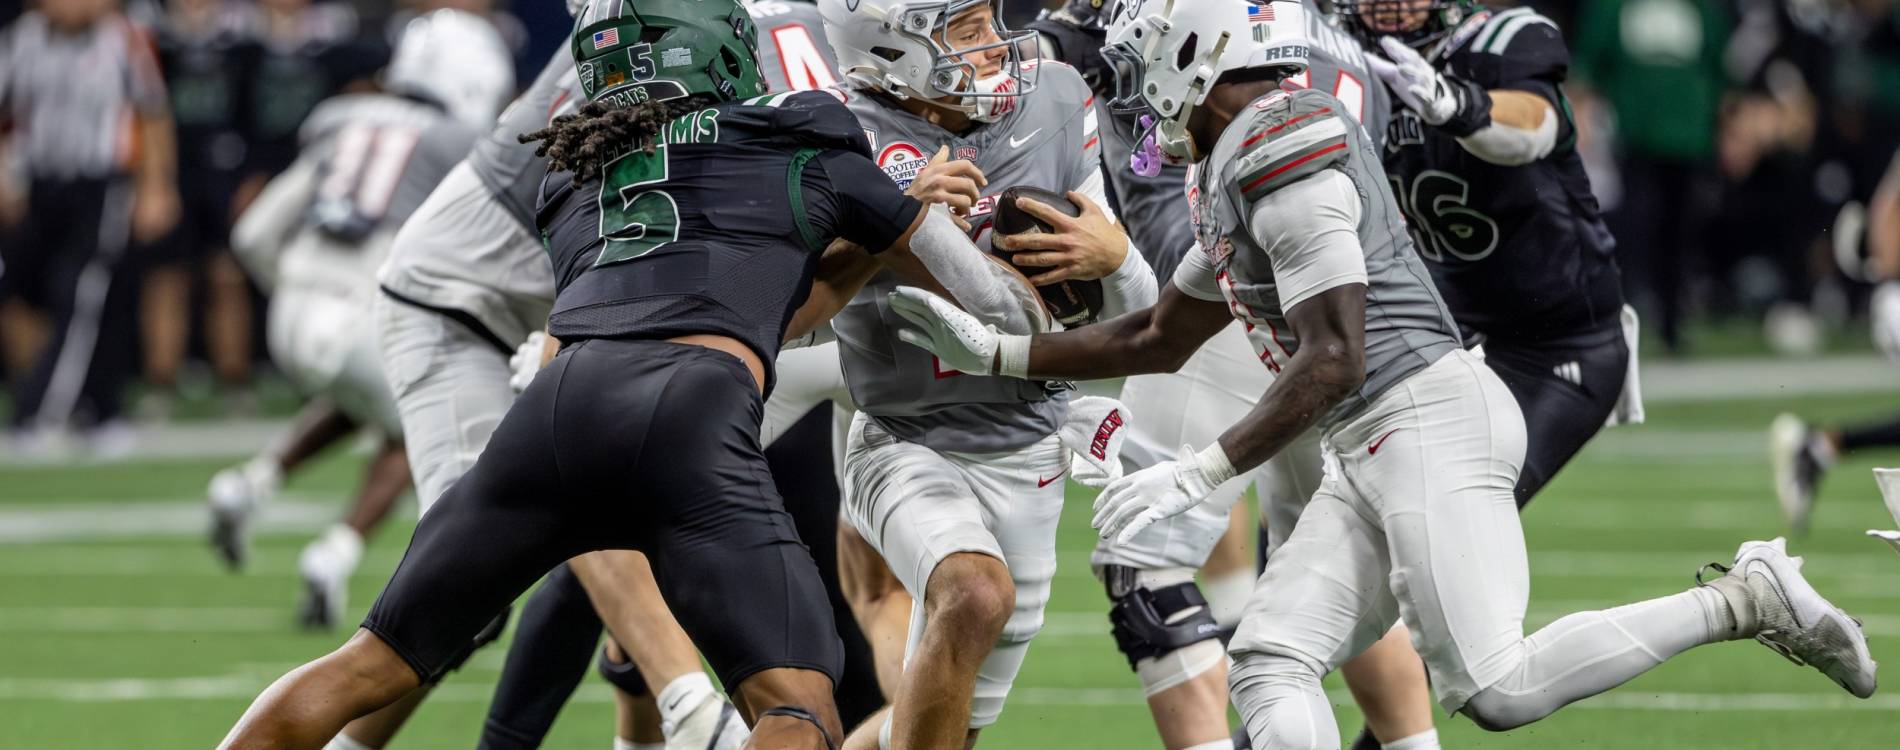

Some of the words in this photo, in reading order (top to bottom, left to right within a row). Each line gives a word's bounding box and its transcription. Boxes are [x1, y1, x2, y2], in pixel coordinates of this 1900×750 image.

[627, 43, 656, 81] 5
[881, 158, 928, 175] COOTER'S
[955, 146, 977, 161] UNLV
[594, 143, 680, 268] 5
[1089, 408, 1123, 461] UNLV
